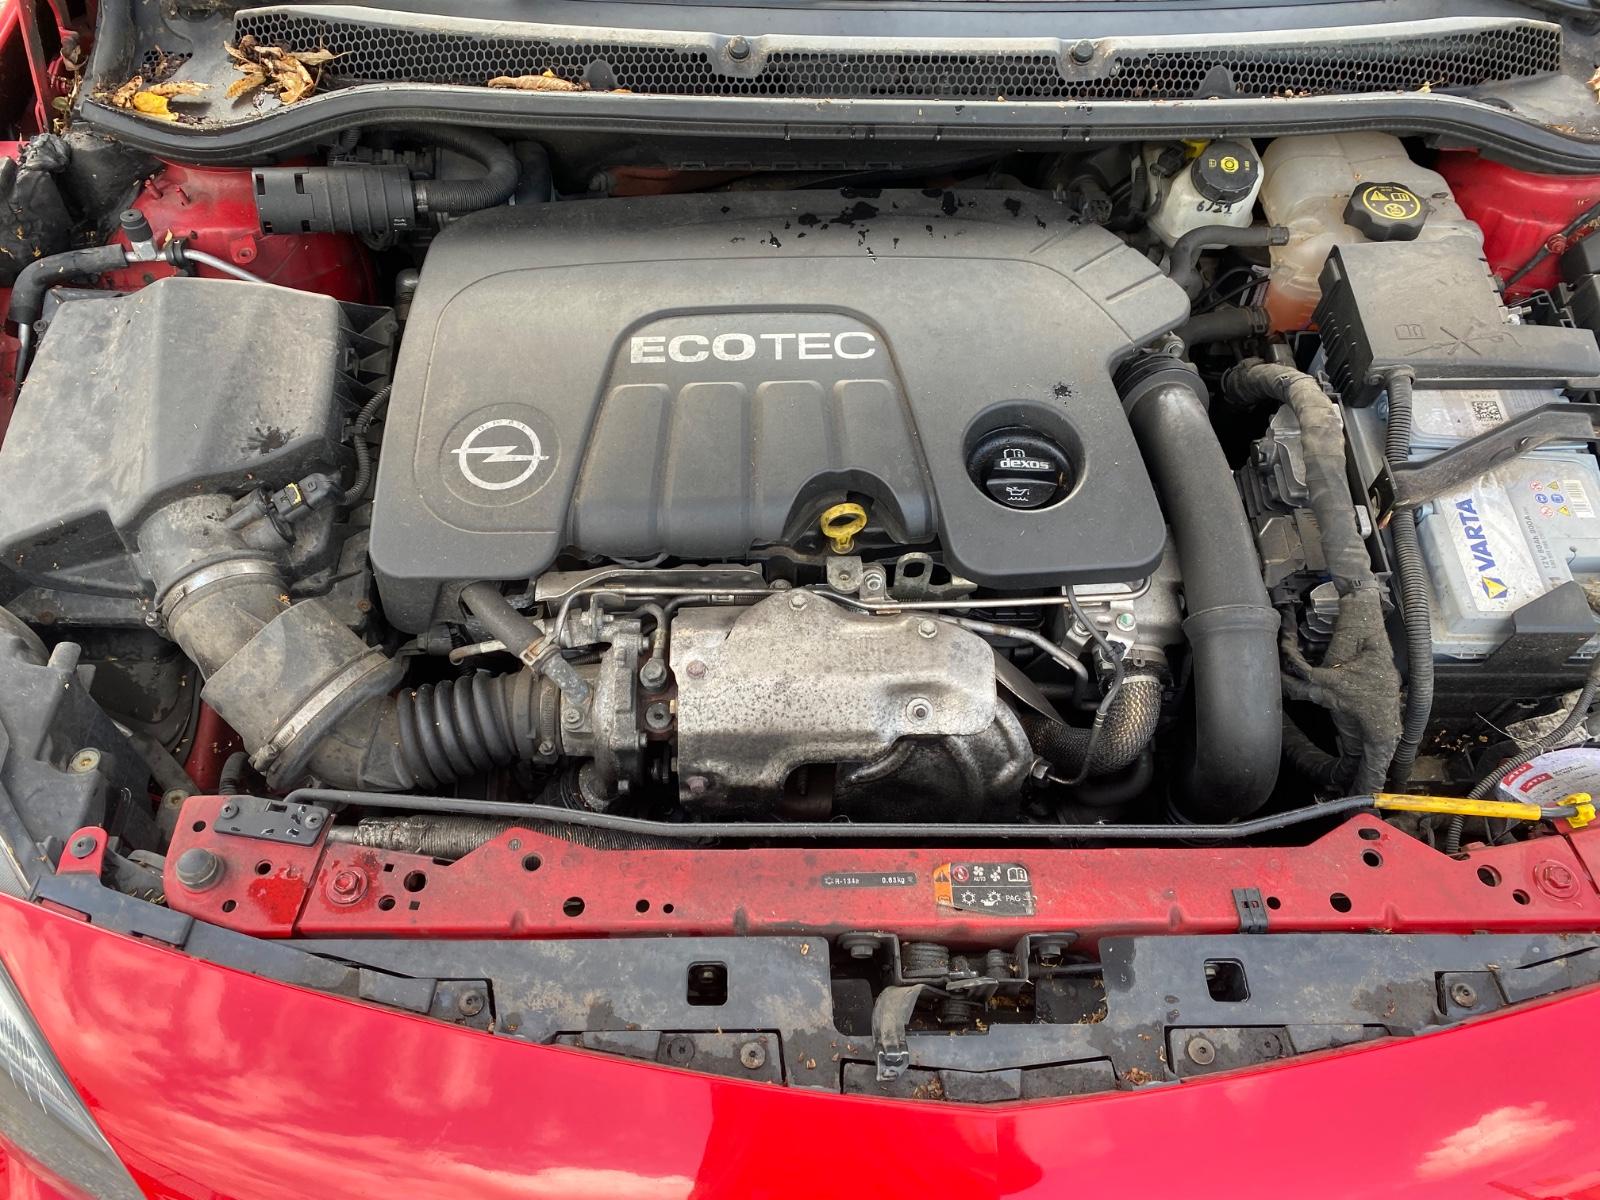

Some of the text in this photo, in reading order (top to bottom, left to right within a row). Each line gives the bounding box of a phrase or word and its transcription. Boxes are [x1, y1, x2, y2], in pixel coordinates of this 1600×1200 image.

[630, 331, 876, 364] ECOTEC
[1000, 458, 1049, 470] dexos
[1456, 498, 1496, 572] VARTA
[1005, 894, 1021, 902] PAG
